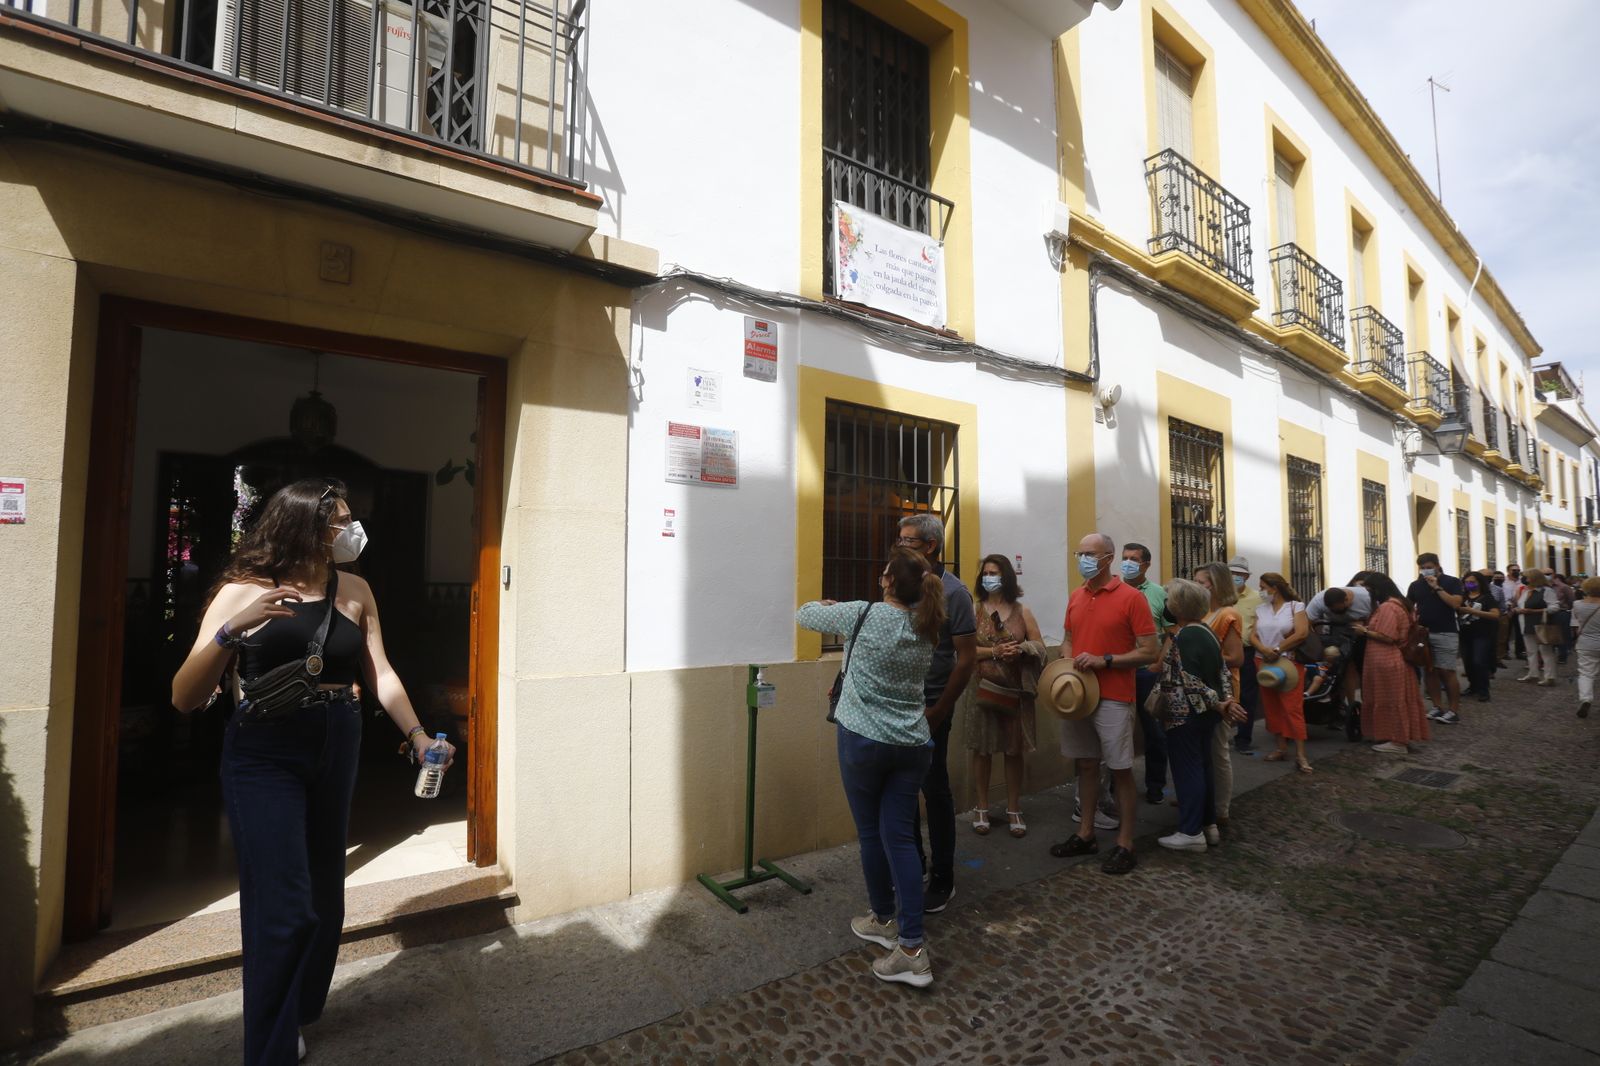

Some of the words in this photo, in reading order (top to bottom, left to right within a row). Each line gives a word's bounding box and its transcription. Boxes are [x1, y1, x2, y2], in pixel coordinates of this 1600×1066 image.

[387, 25, 412, 40] FUJITS
[874, 244, 888, 255] Las
[889, 249, 906, 262] flores
[908, 259, 937, 273] cantando
[884, 271, 890, 280] la
[891, 275, 906, 286] jaula
[907, 280, 917, 290] del
[901, 268, 914, 277] que
[876, 283, 902, 296] colgada
[912, 293, 919, 302] la
[747, 342, 776, 355] Alarma
